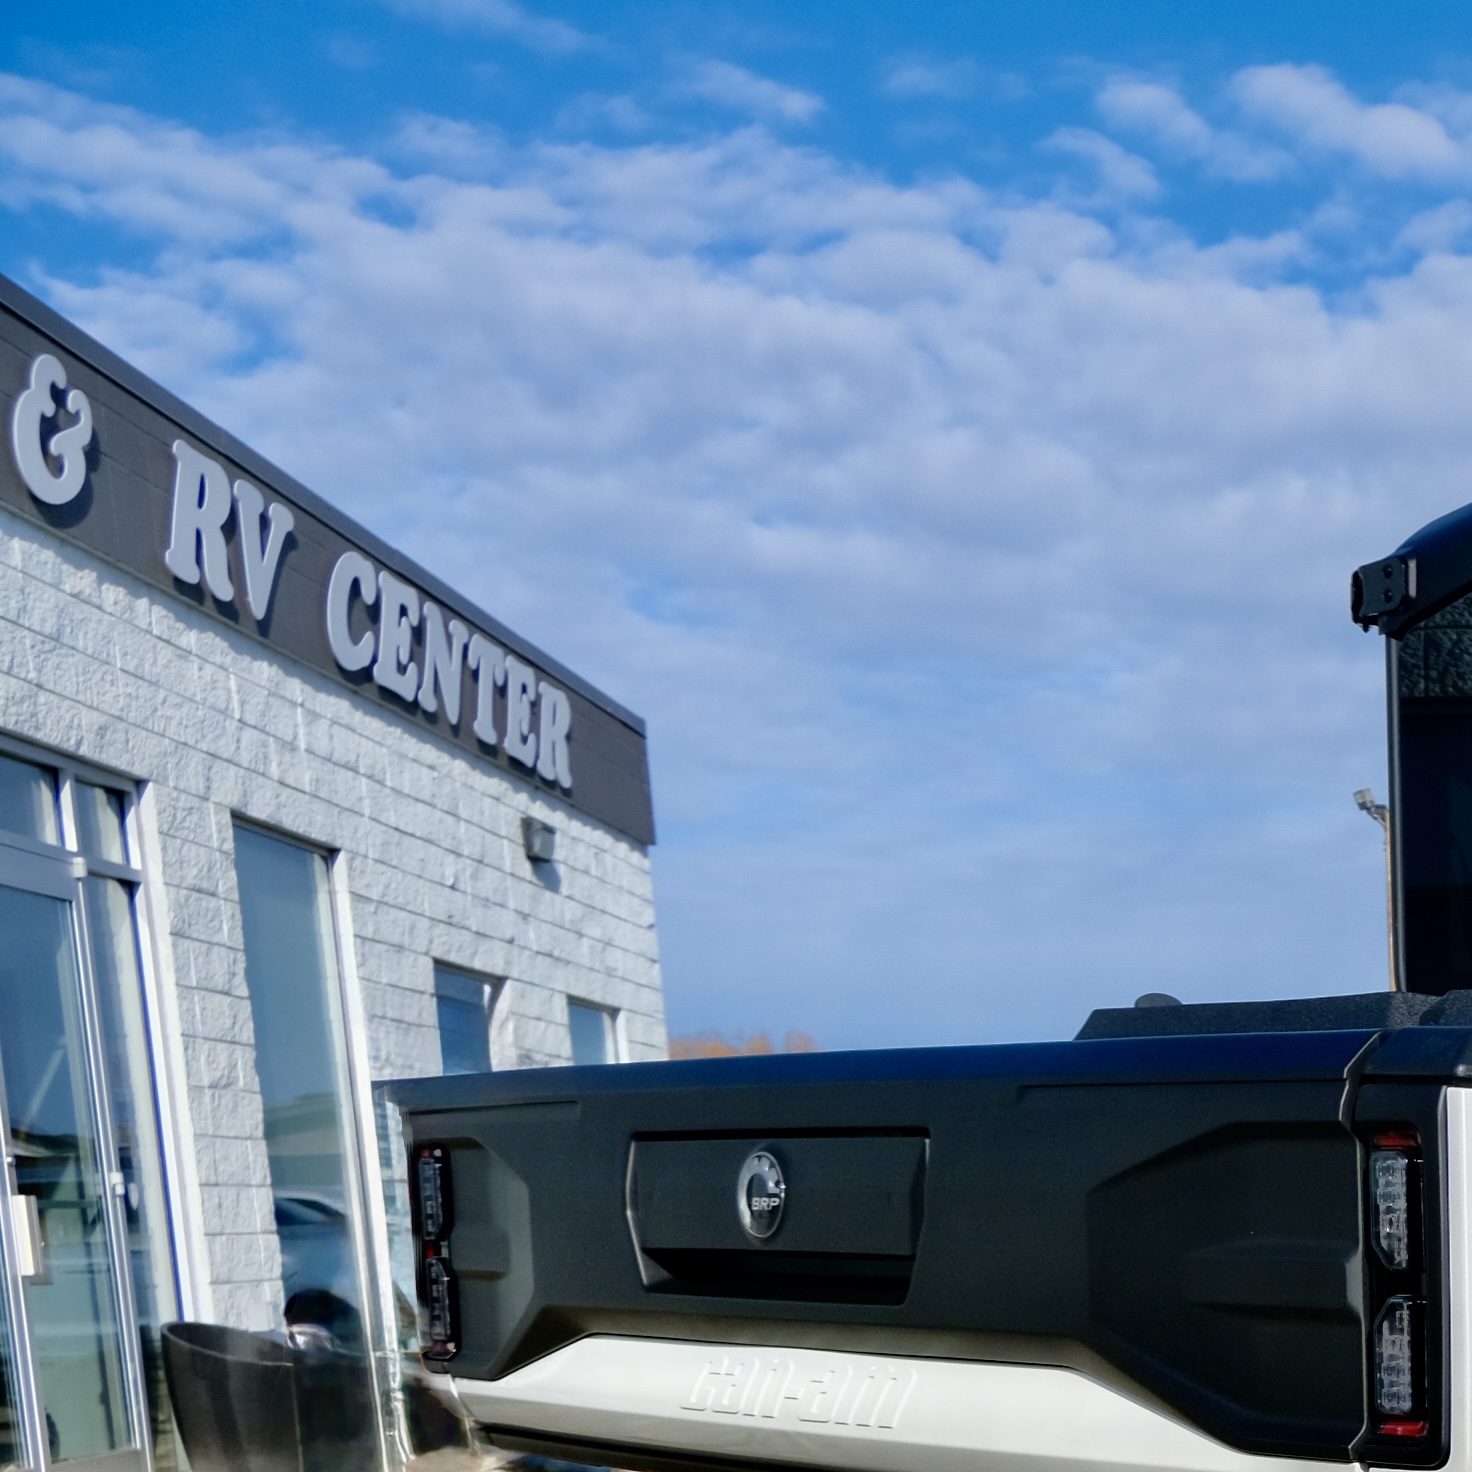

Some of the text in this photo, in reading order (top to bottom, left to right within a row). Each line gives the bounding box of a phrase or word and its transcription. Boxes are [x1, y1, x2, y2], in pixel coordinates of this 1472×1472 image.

[13, 353, 573, 790] & RV CENTER
[751, 1196, 780, 1211] BRP
[680, 1354, 918, 1429] can-am
